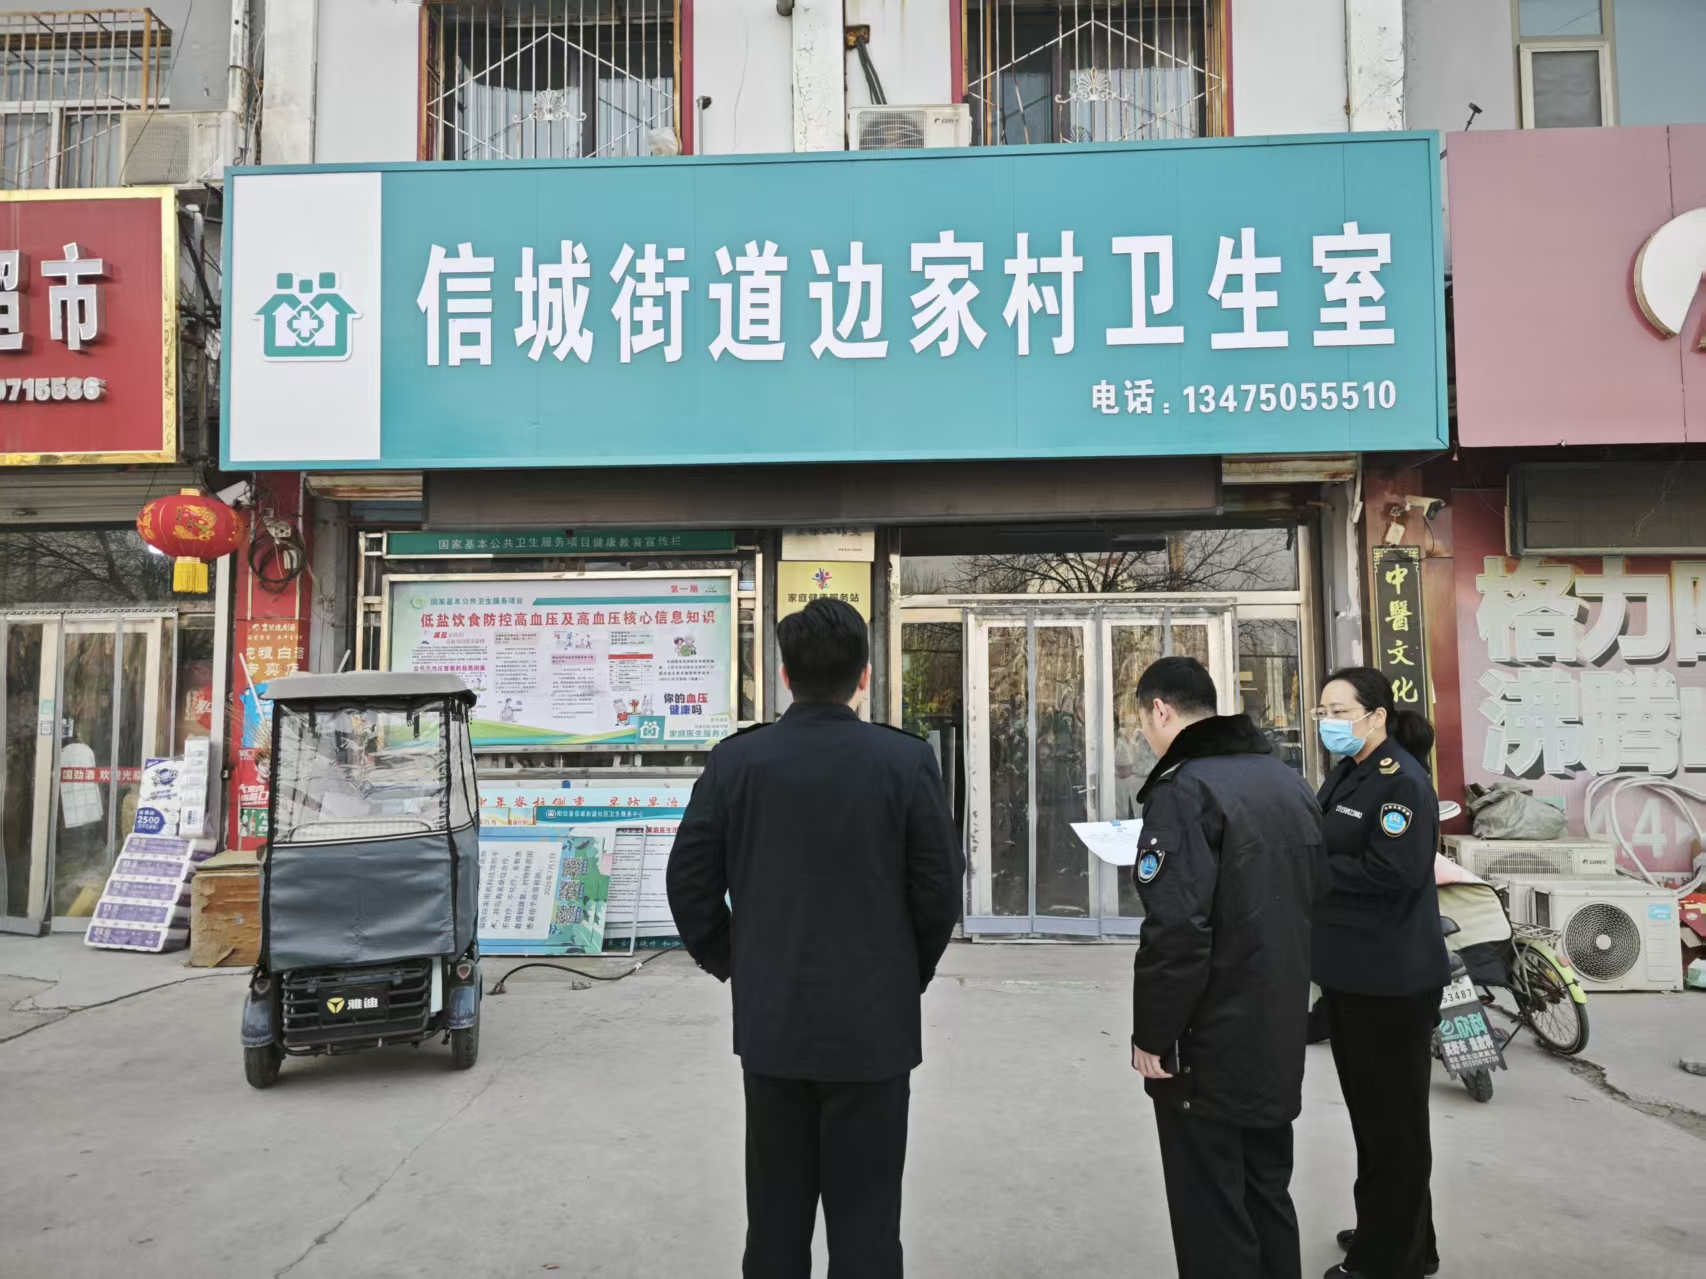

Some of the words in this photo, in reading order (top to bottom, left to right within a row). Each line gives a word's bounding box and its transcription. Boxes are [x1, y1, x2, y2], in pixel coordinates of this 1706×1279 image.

[417, 221, 1395, 366] 信城街道边家村卫生室
[438, 536, 682, 550] 国家基本公共卫生服务项目健康教育宣传栏
[430, 596, 523, 606] 国家基本公共卫生服务项目
[420, 610, 717, 628] 低盐饮食防控高血压及高血压核心信息知识
[1385, 564, 1419, 703] 中醫文化
[664, 692, 708, 704] 你的血压
[669, 704, 703, 716] 健康吗
[669, 729, 729, 738] 家庭医生服务点
[137, 816, 160, 824] 2500
[347, 997, 378, 1010] 雅迪
